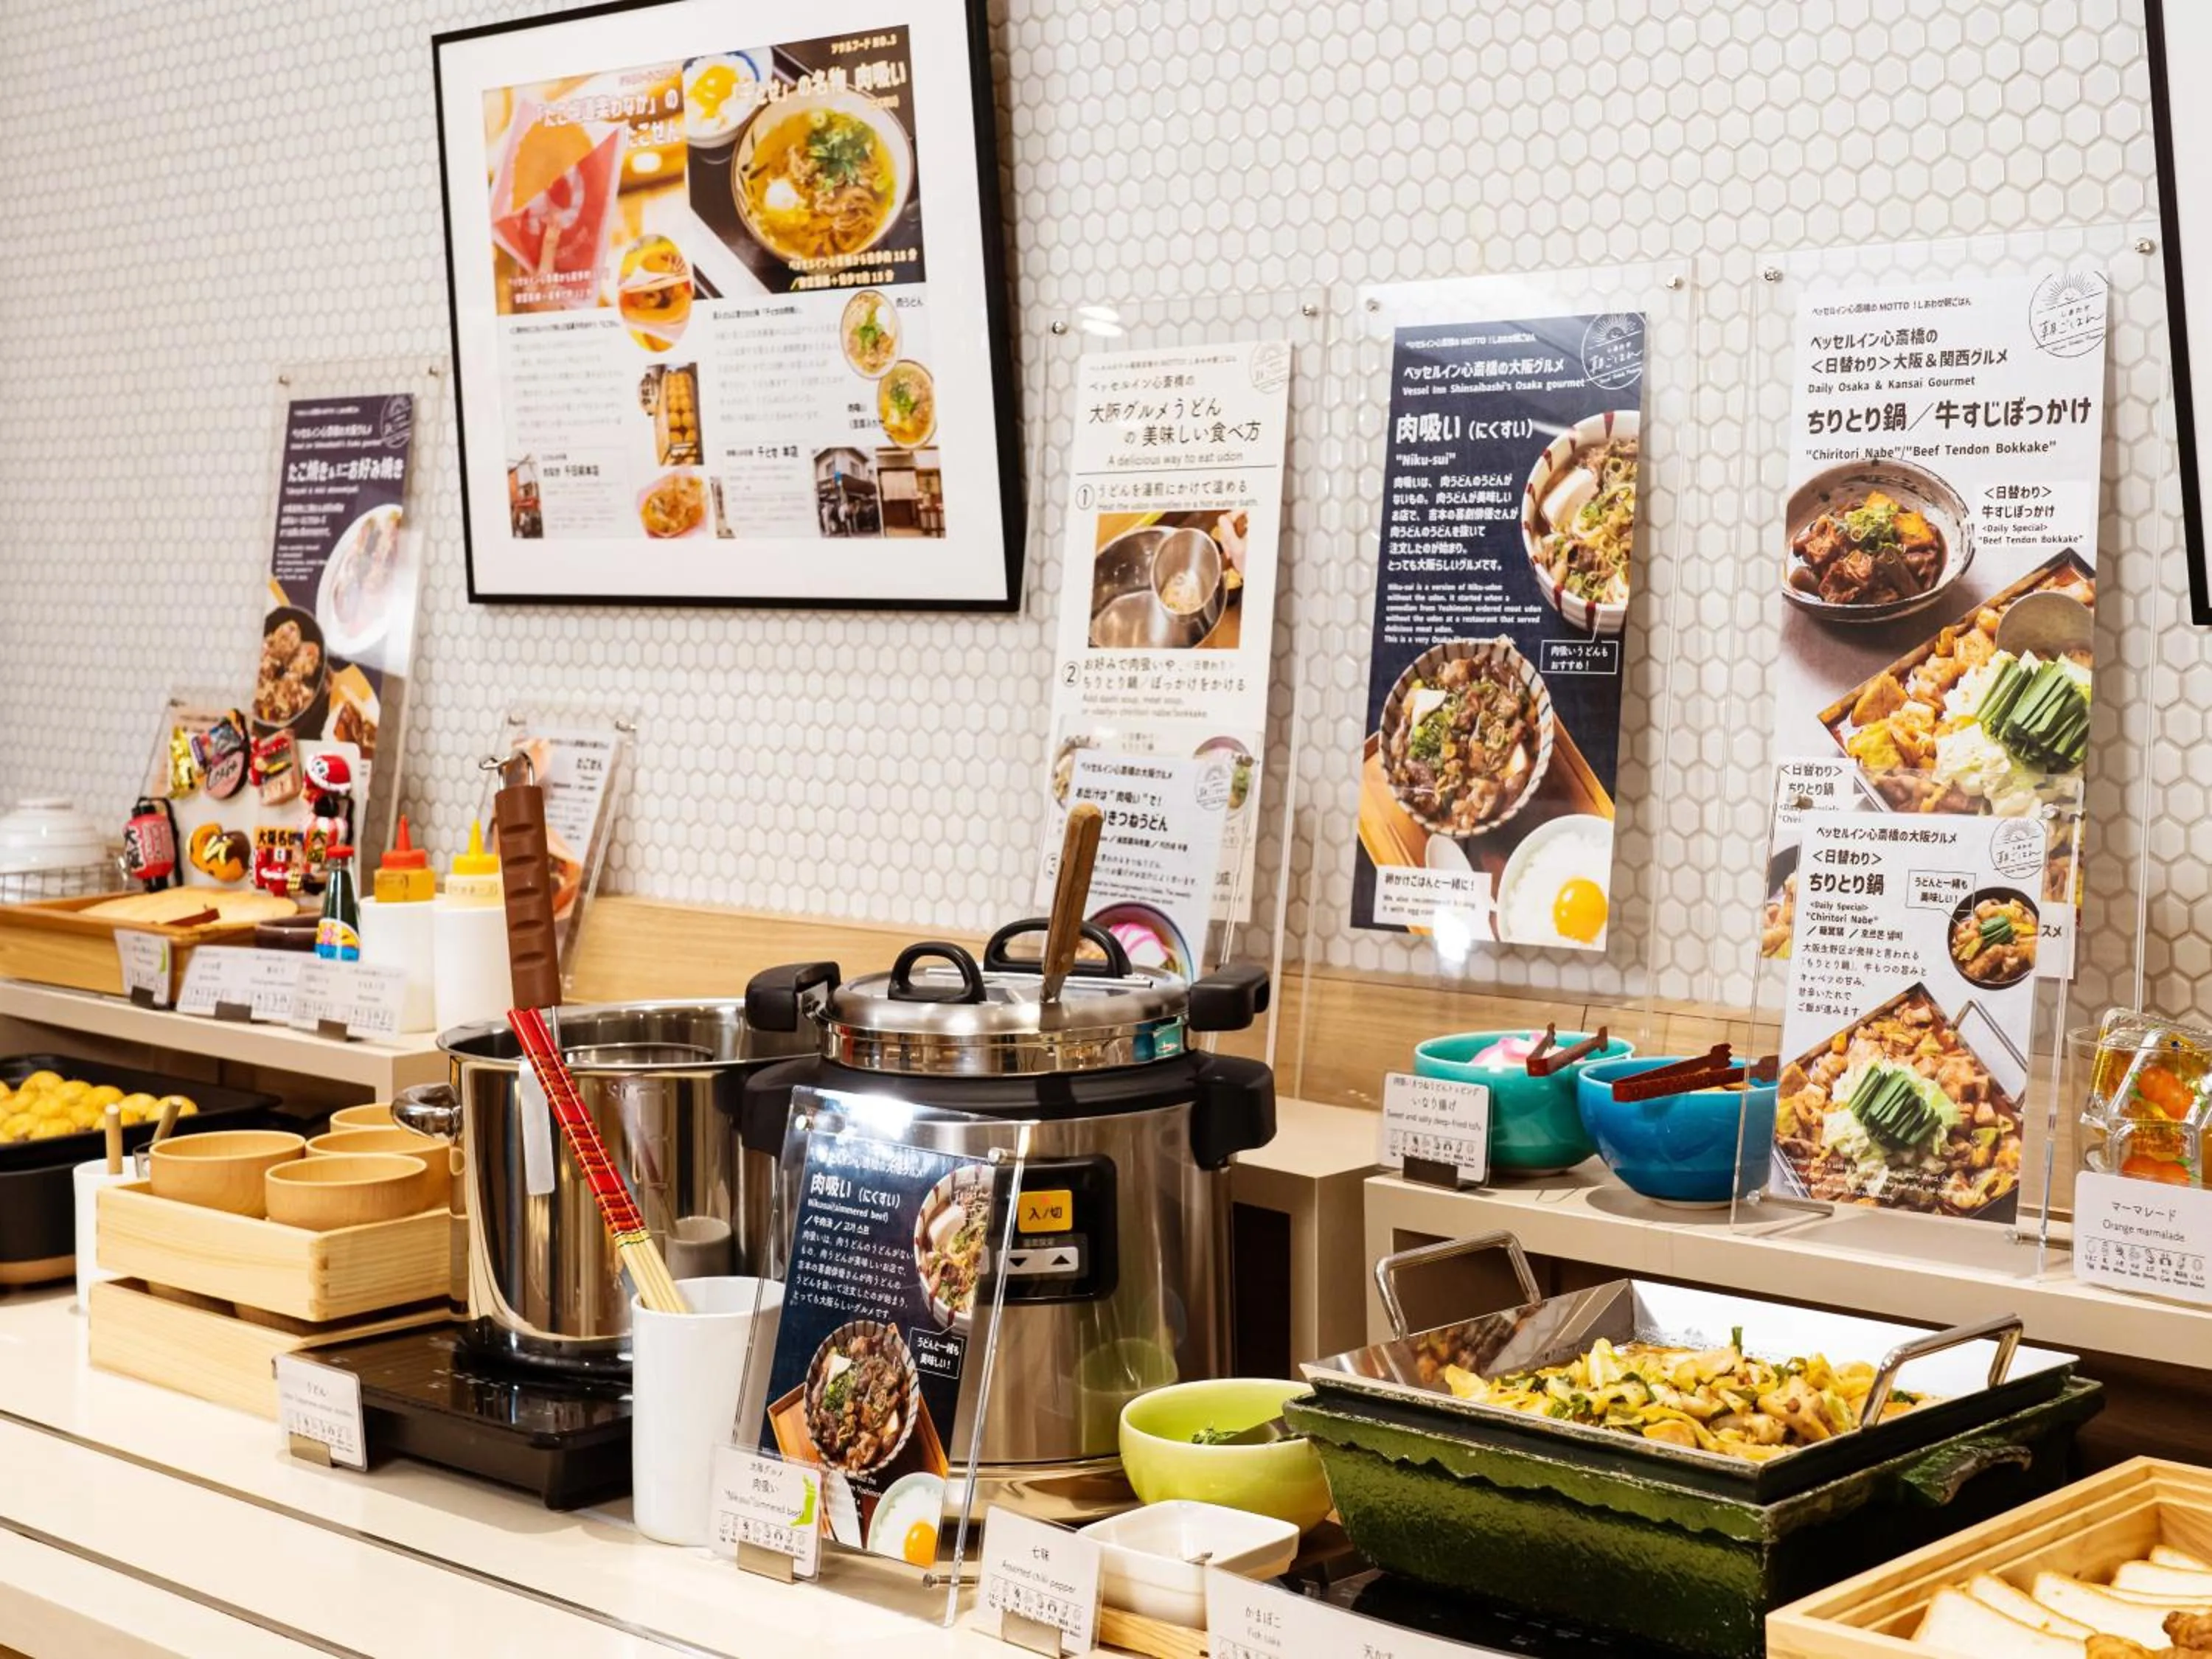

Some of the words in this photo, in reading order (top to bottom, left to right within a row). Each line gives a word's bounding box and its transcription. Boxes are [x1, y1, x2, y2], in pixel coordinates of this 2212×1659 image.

[1811, 327, 1938, 349] ベッセルイン心斎橋の
[1403, 358, 1565, 380] ベッセルイン心斎橋の大阪グルメ
[1402, 386, 1429, 396] Vessel
[1433, 385, 1446, 394] Inn
[1515, 381, 1543, 390] Osaka
[1547, 378, 1585, 390] gourmet
[1808, 383, 1833, 394] Daily
[1838, 382, 1869, 392] Osaka
[1875, 380, 1882, 389] &
[1888, 378, 1923, 389] Kansai
[1928, 376, 1975, 387] Gourmet
[1088, 397, 1222, 423] 大阪グルメうどん
[1396, 413, 1461, 443] 肉吸い
[1946, 443, 1989, 456] Tendon
[1982, 505, 2055, 518] 牛すじぼっかけ
[1817, 827, 1957, 844] ベッセルイン心斎橋の大阪グルメ
[1809, 872, 1884, 896] ちりとり鍋
[810, 1172, 852, 1198] 肉吸い
[2112, 1201, 2177, 1221] マーマレード
[2103, 1219, 2134, 1234] Orange
[2137, 1225, 2185, 1242] marmalade
